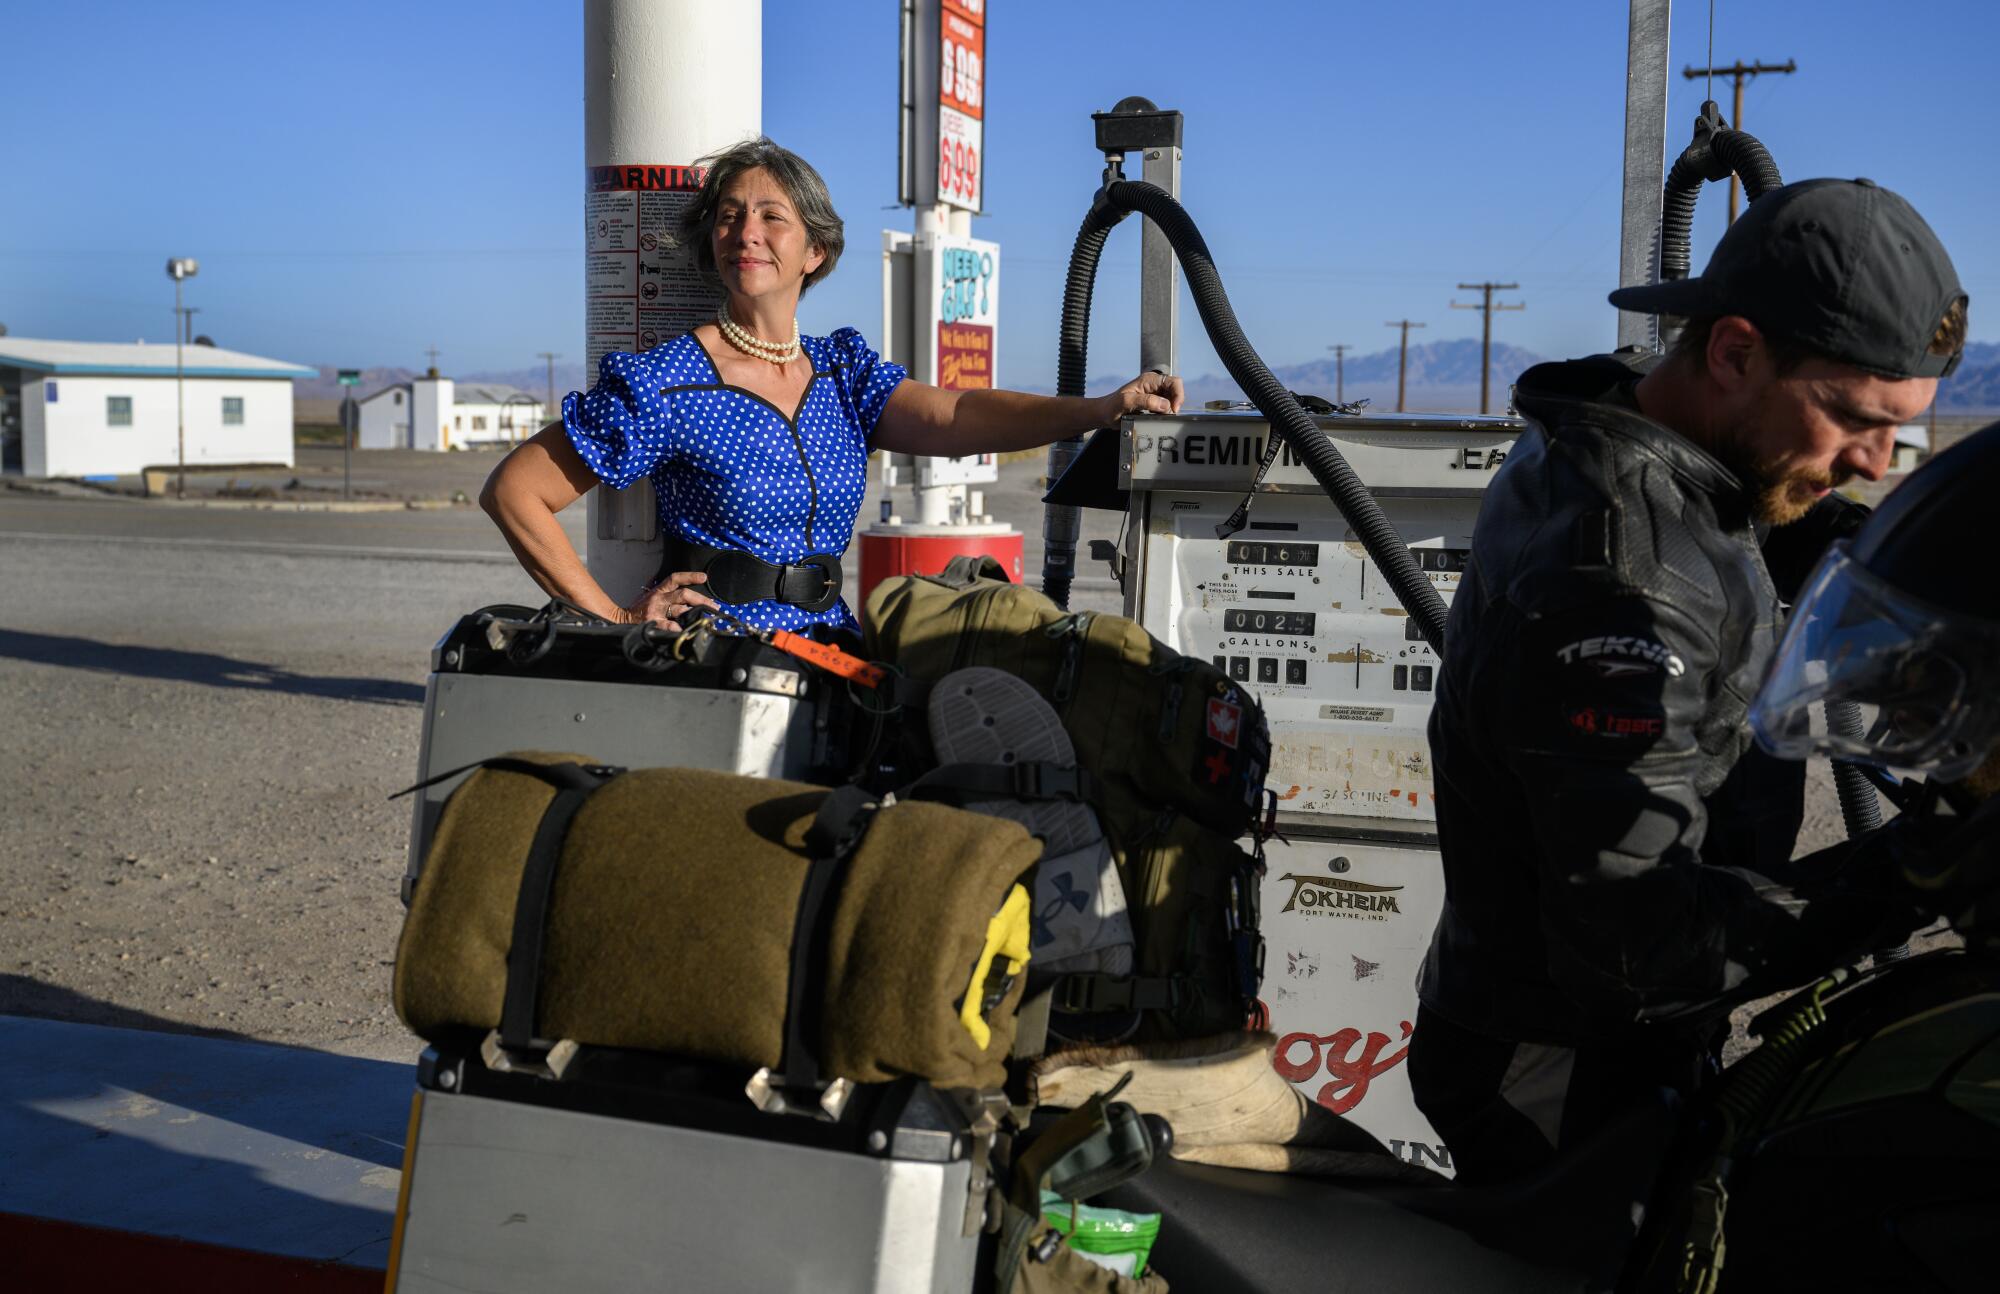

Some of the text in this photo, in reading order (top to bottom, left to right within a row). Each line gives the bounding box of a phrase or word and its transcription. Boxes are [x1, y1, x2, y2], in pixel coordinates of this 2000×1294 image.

[941, 136, 977, 201] 699
[592, 167, 702, 189] WARNIN
[942, 247, 980, 288] NEED
[1233, 566, 1313, 577] THIS SALE
[1229, 638, 1309, 649] GALLONS
[1319, 879, 1359, 889] QUALITY
[1278, 872, 1404, 914] TOKHEIM
[1328, 912, 1364, 920] WAYNE,
